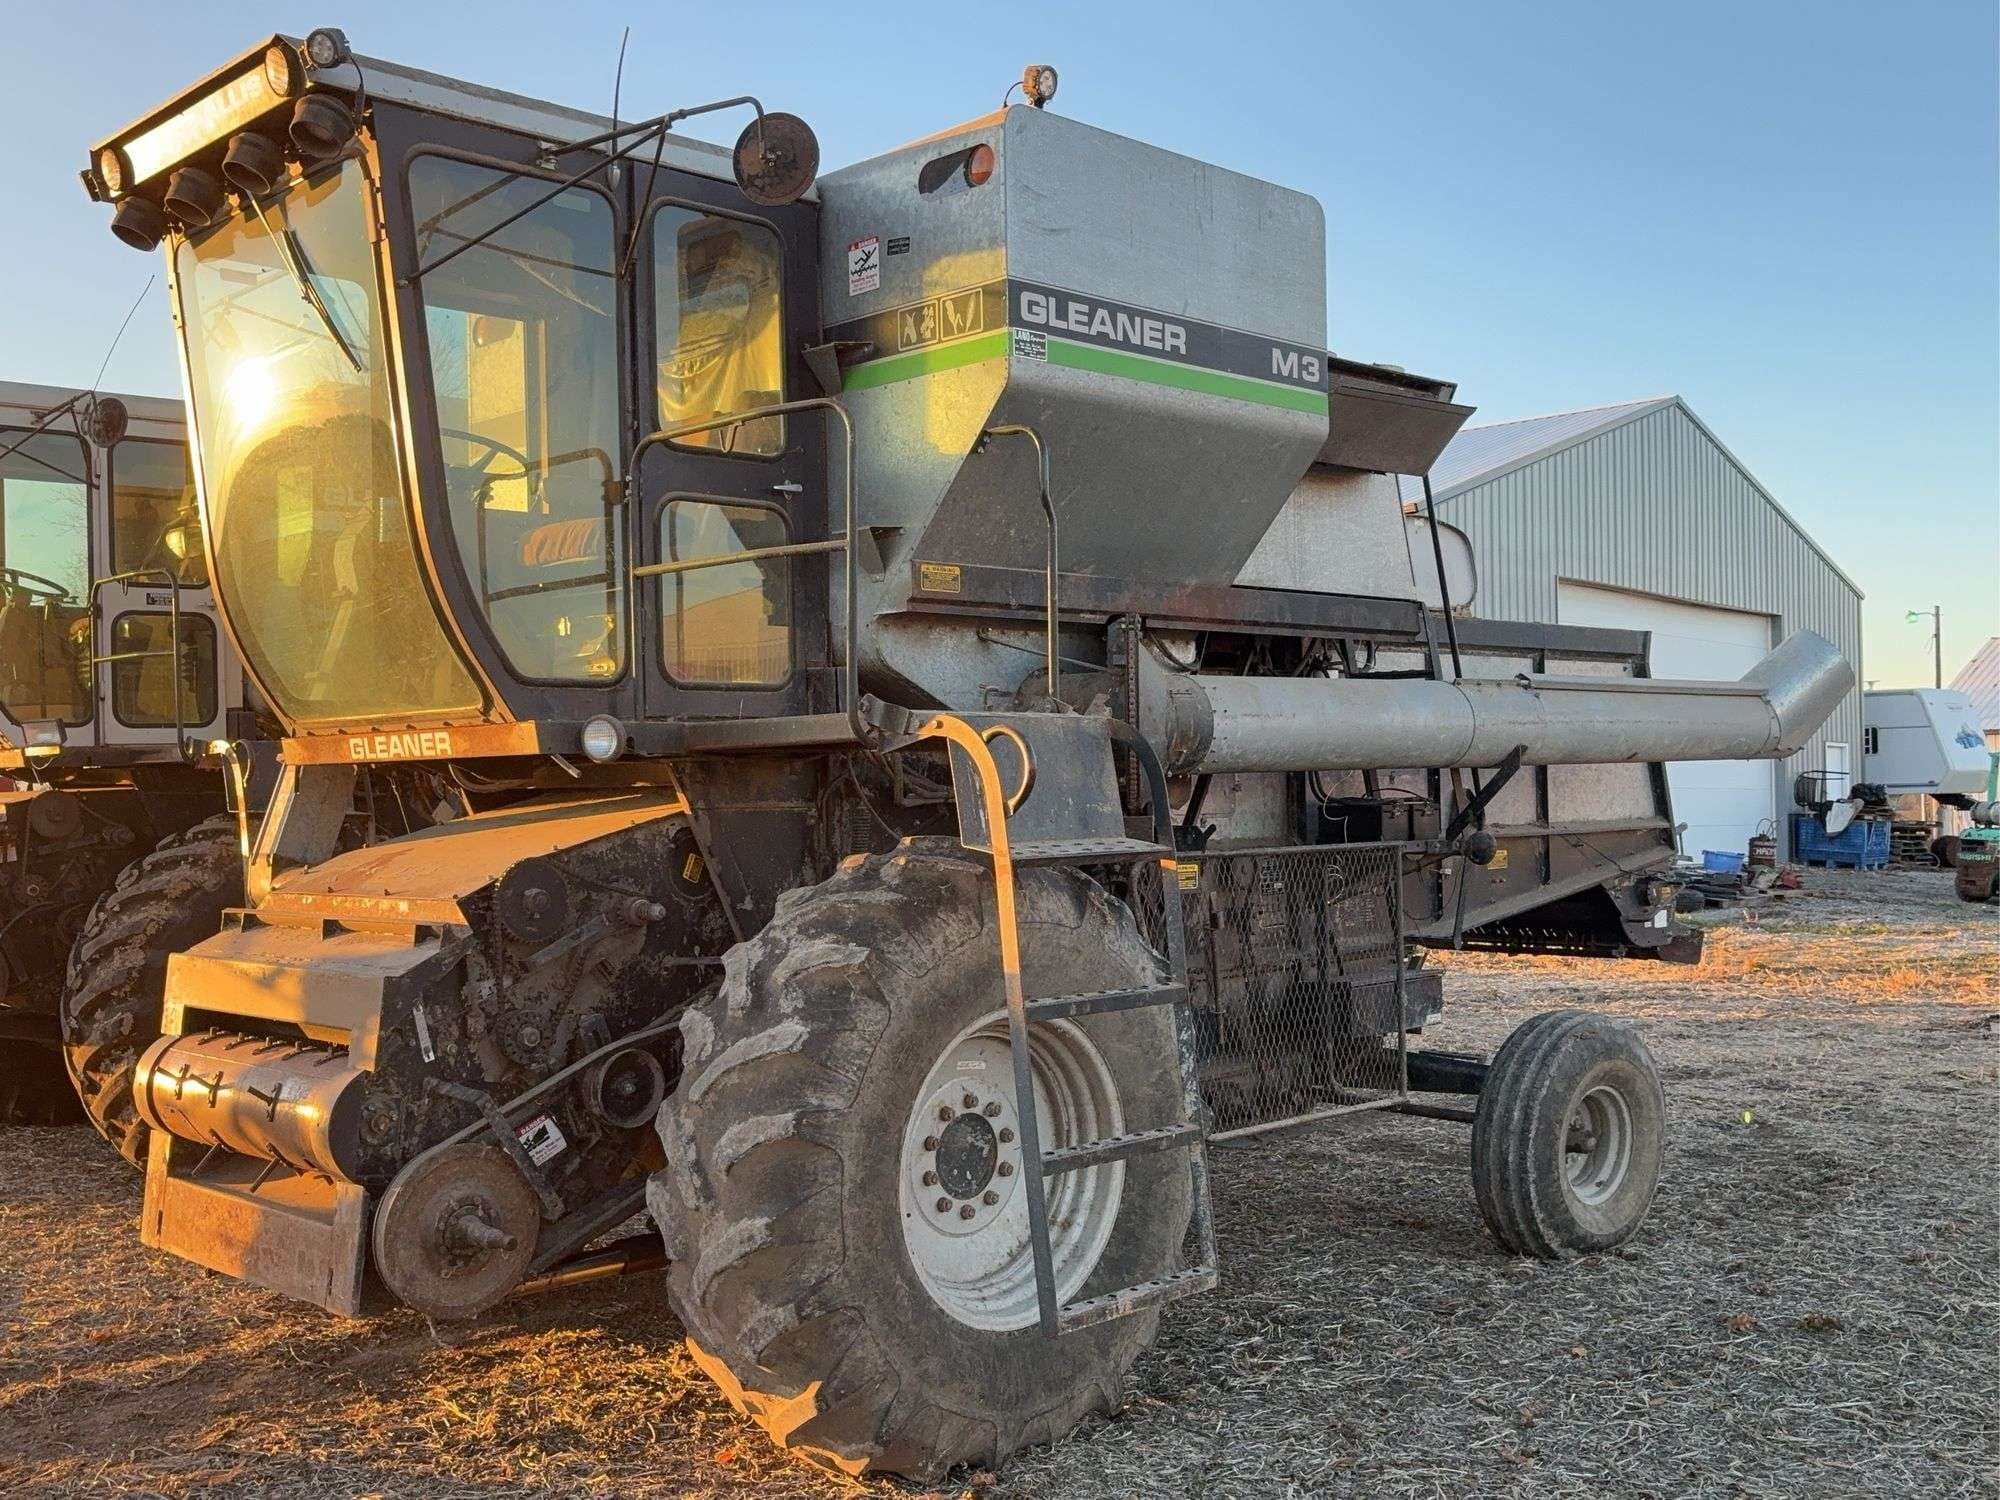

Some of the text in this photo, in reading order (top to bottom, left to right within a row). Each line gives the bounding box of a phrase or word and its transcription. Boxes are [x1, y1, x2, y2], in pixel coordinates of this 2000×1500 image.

[1020, 291, 1187, 355] GLEANER
[1272, 347, 1321, 384] M3
[349, 730, 452, 761] GLEANER
